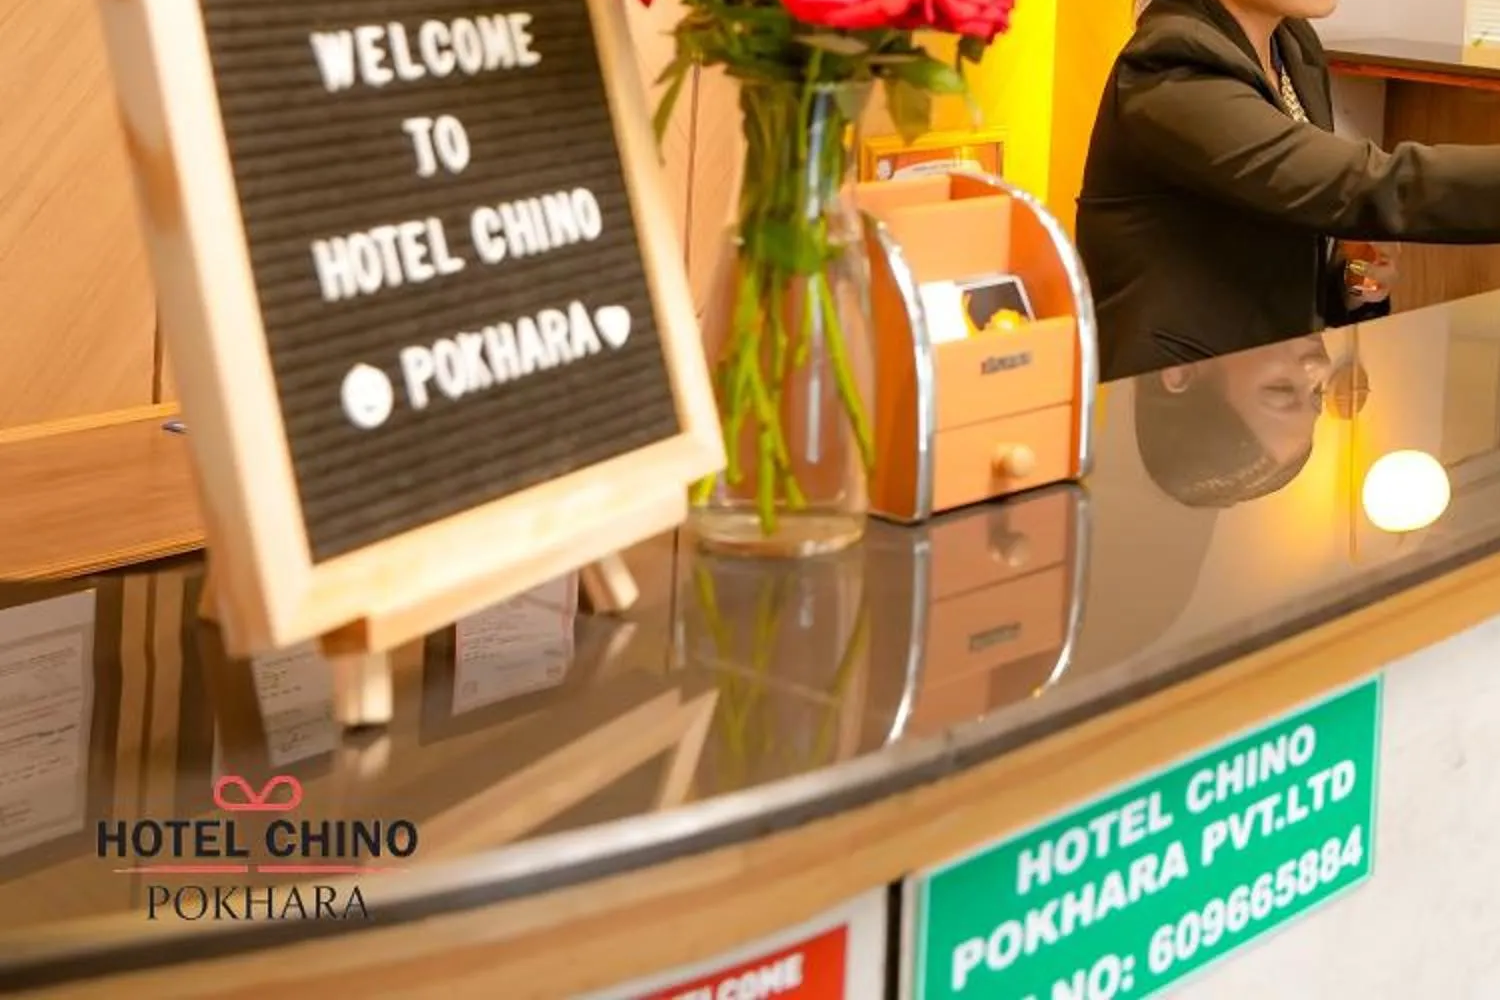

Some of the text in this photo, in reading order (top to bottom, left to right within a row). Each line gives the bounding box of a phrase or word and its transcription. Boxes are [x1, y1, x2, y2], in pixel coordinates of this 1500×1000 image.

[310, 13, 541, 92] WELCOME
[402, 115, 471, 178] TO
[311, 187, 603, 301] HOTEL CHINO
[400, 300, 600, 408] POKHARA
[1015, 724, 1316, 895] HOTEL CHINO
[950, 759, 1357, 992] POKHARA PVT.LTD
[1147, 824, 1364, 974] 609665884
